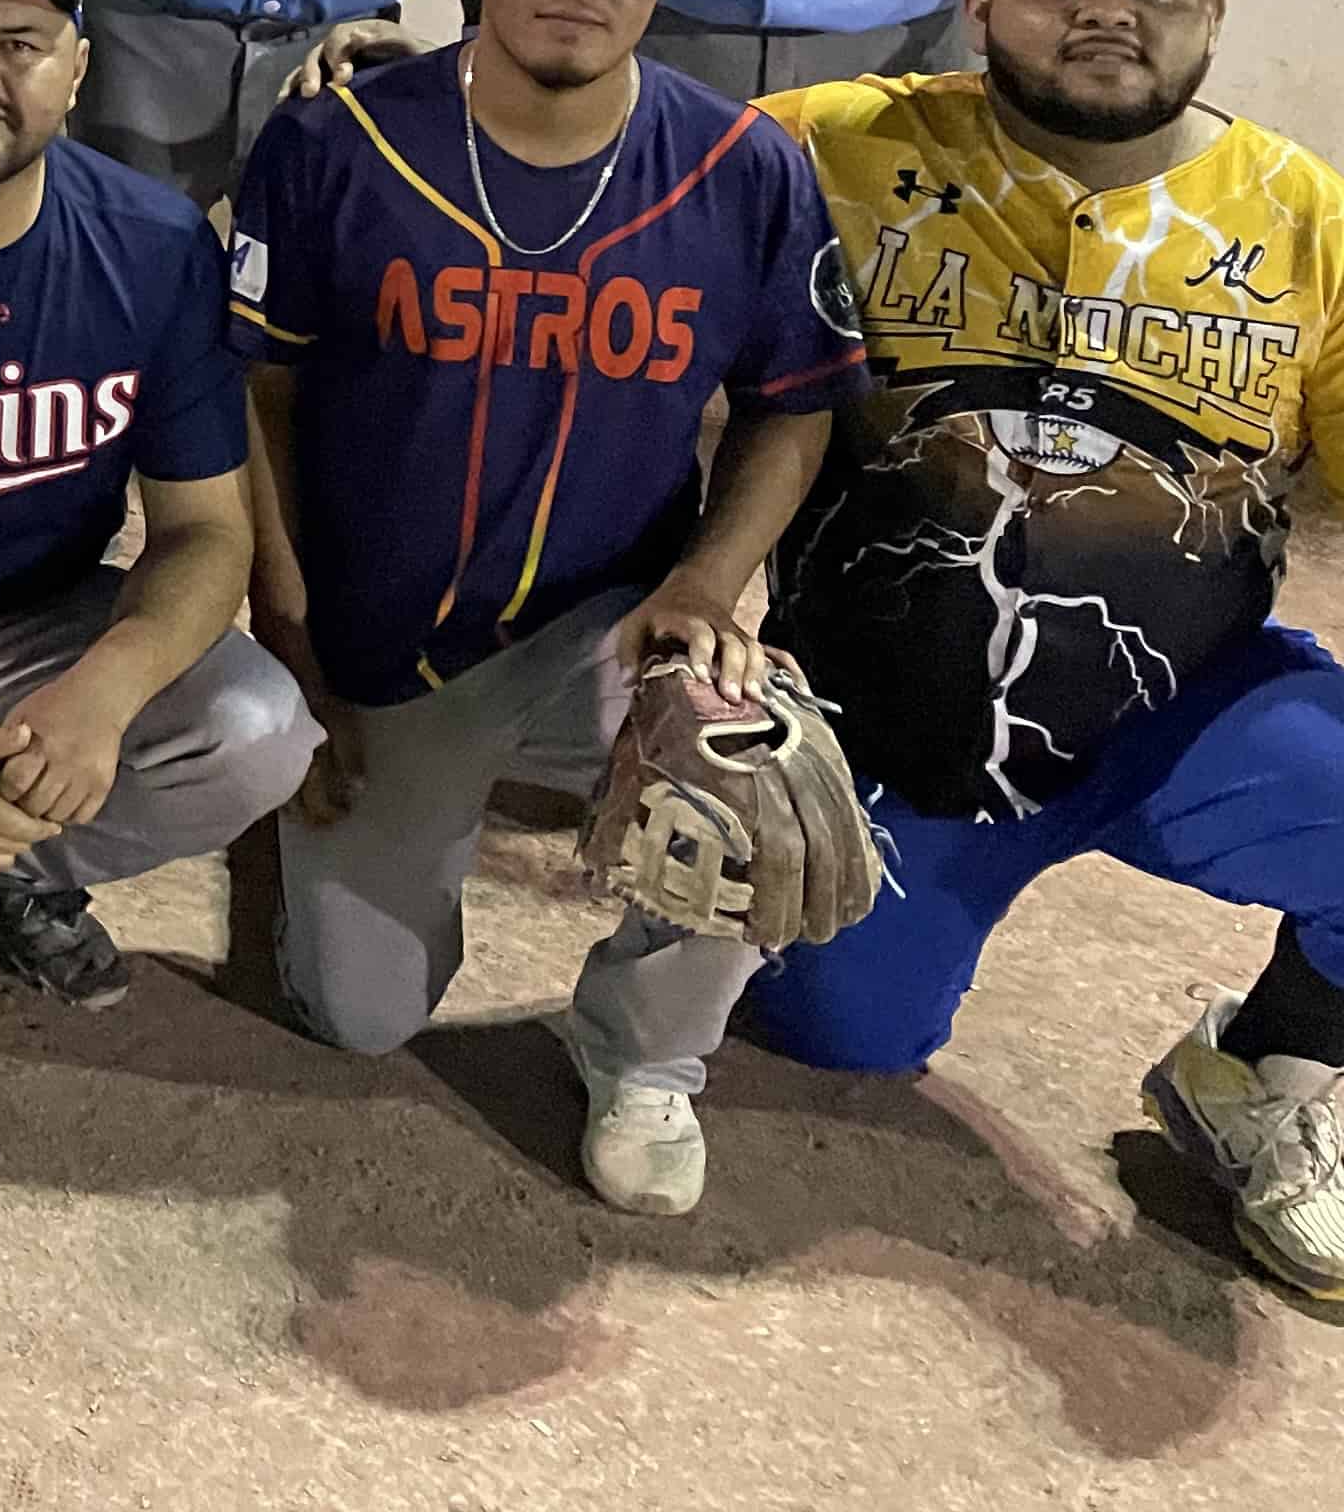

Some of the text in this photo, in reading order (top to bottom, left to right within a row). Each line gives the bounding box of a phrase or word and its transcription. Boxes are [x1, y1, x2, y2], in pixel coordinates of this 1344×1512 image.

[375, 256, 703, 382] ASTROS
[863, 224, 1300, 415] LA NOCHE
